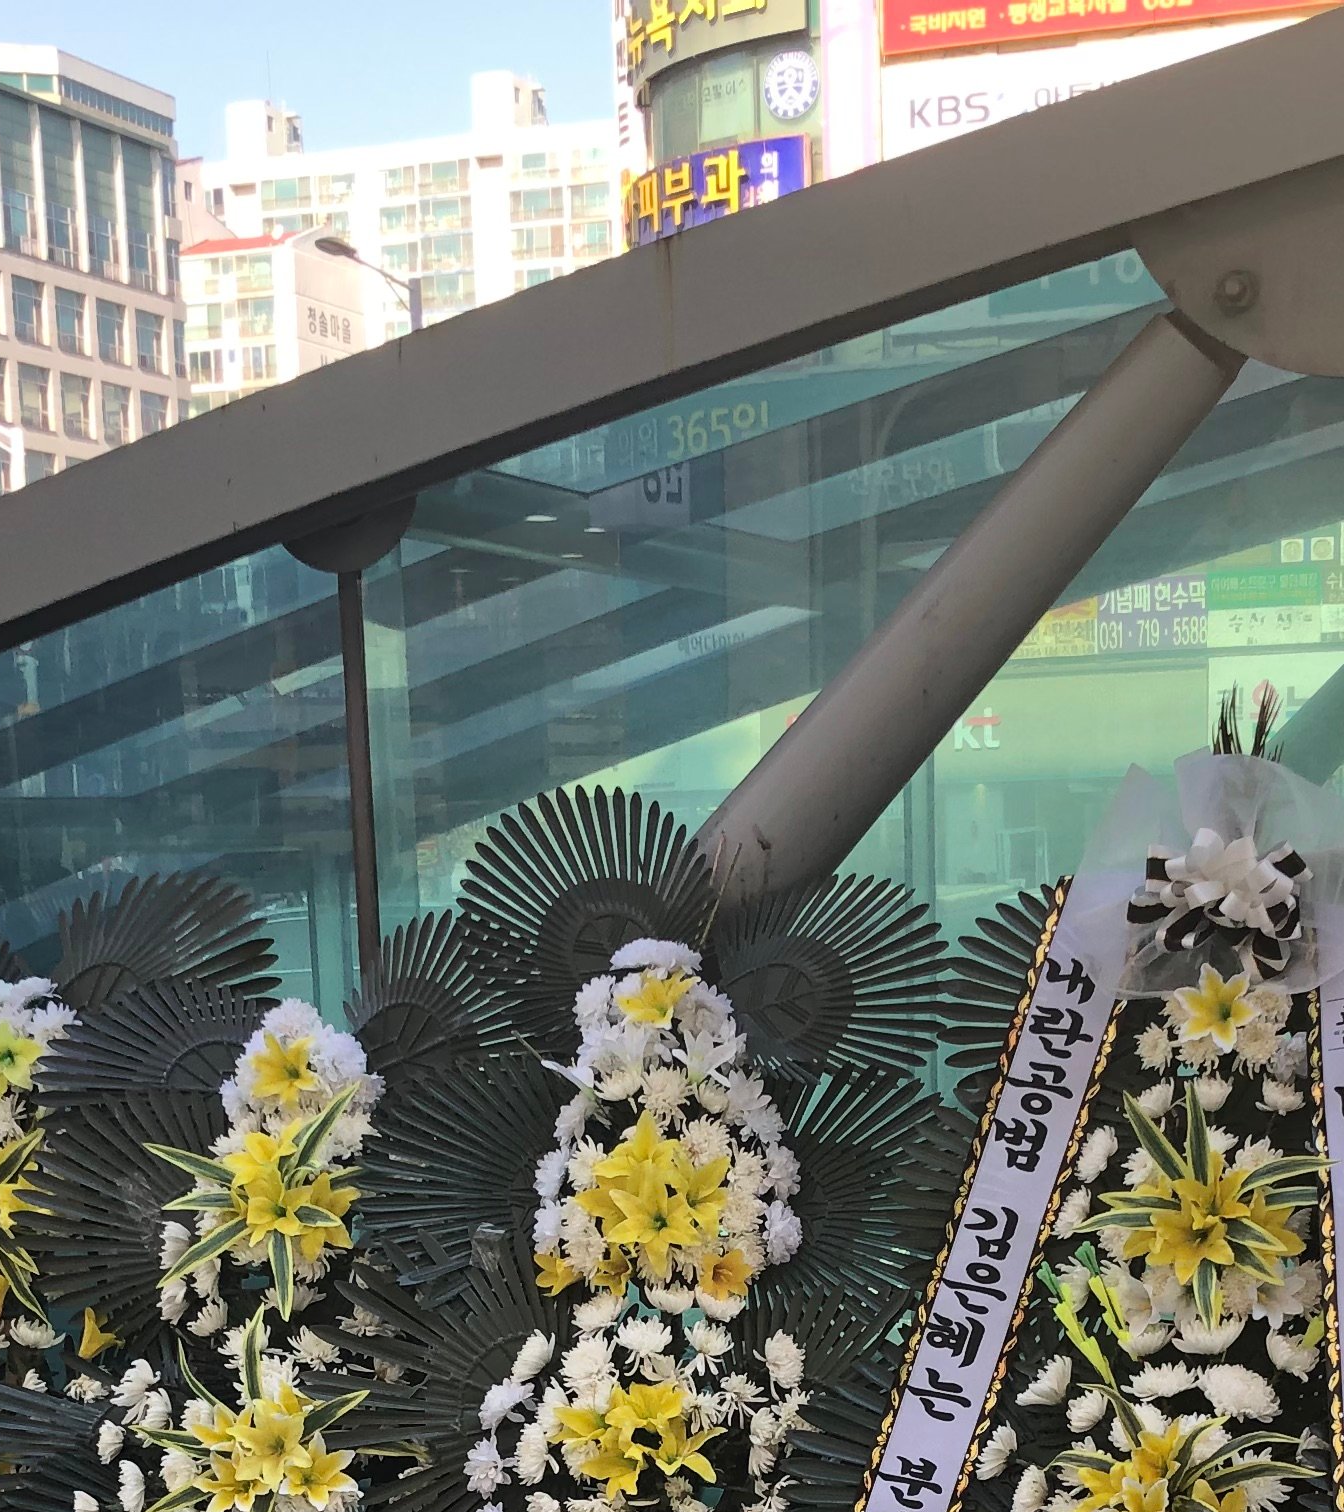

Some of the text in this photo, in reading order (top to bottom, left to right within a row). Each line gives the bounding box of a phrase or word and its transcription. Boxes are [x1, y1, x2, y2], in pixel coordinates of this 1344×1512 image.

[908, 11, 987, 34] 국비지원
[910, 91, 991, 129] KBS
[638, 150, 748, 232] 피부과
[307, 305, 351, 344] 청솔마을
[1154, 580, 1207, 612] 현수막
[954, 707, 1002, 749] kt
[992, 957, 1094, 1172] 내란공범
[907, 1206, 1020, 1422] 김은혜는
